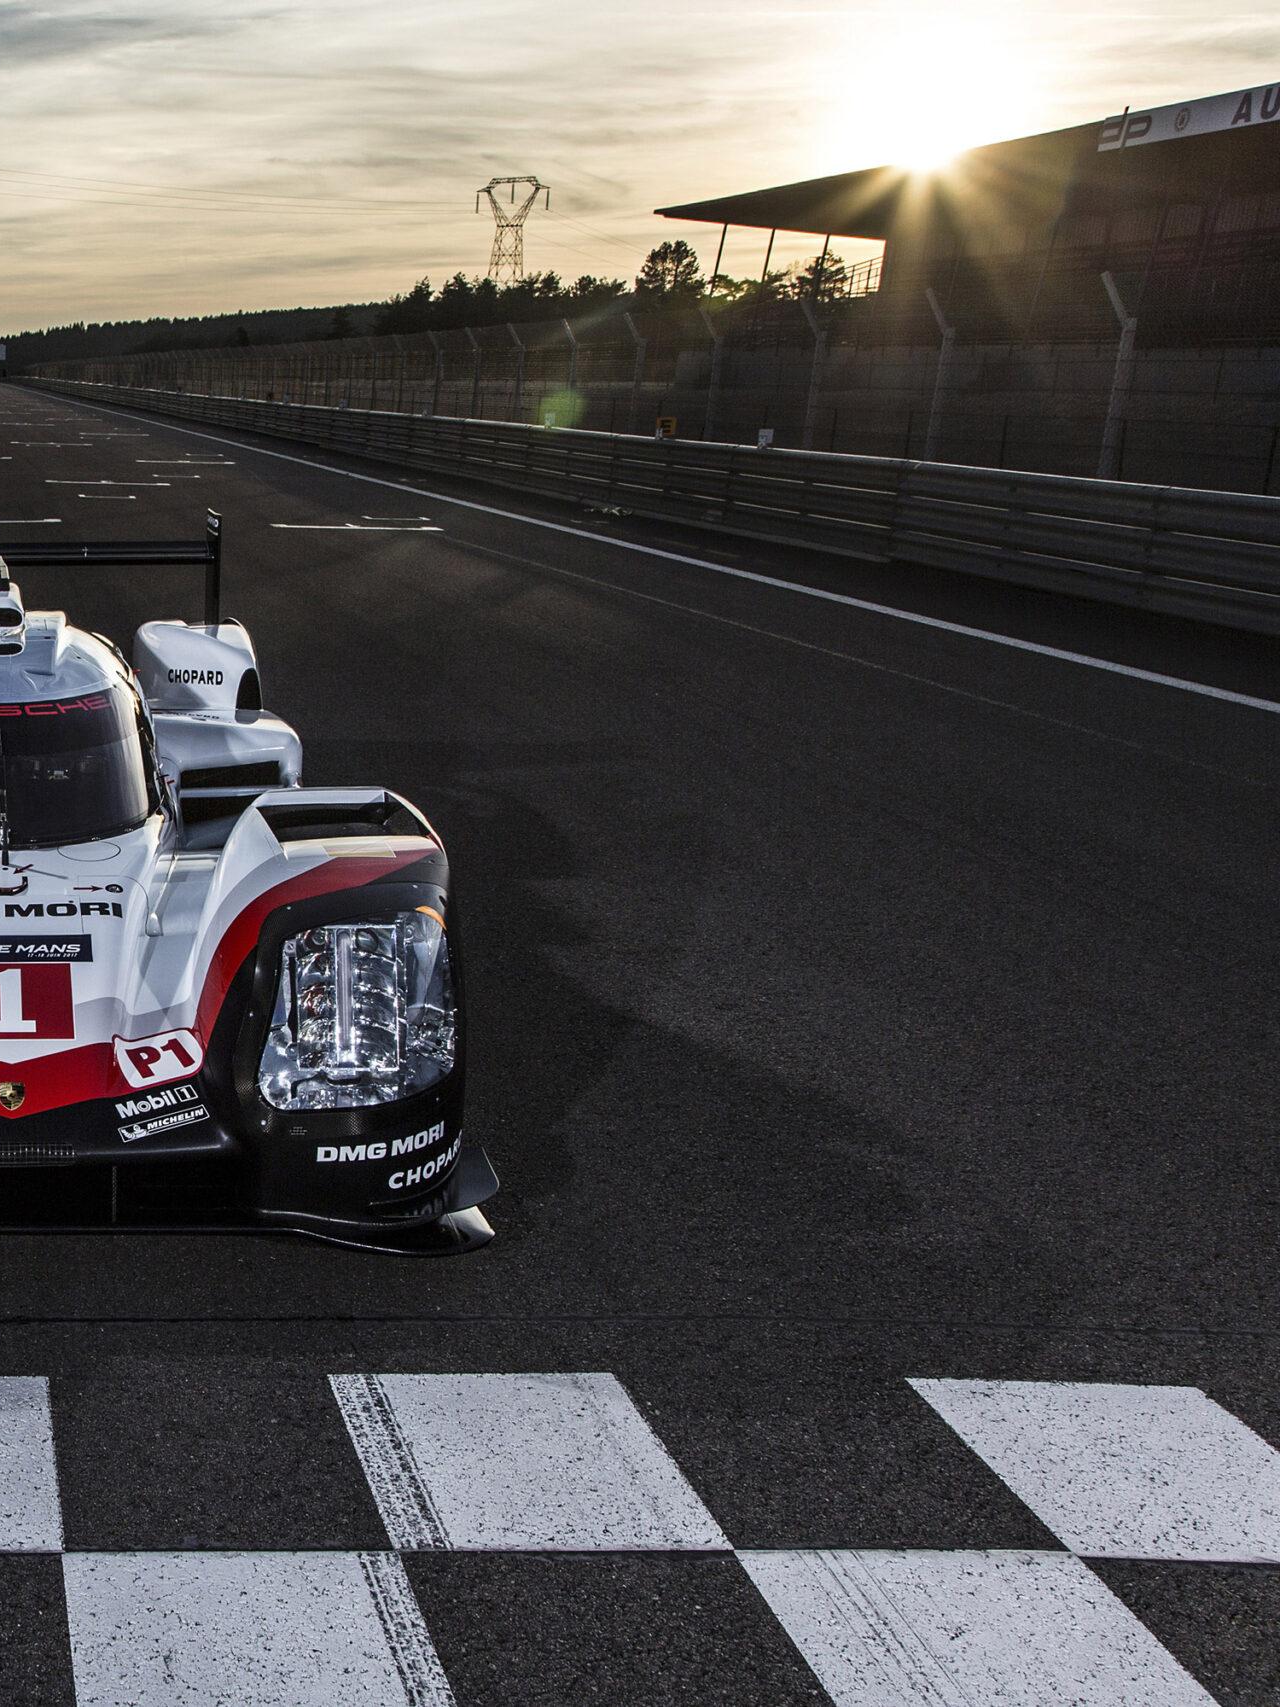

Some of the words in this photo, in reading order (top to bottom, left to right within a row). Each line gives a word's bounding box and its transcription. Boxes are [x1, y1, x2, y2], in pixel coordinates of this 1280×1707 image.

[167, 669, 224, 685] CHOPARD
[4, 902, 123, 918] MORI
[15, 944, 80, 953] MANS
[125, 1038, 195, 1079] P1
[115, 1090, 177, 1119] Mobil
[146, 1108, 204, 1130] MICHELIN
[316, 1143, 387, 1162] DMG
[391, 1120, 444, 1157] MORI
